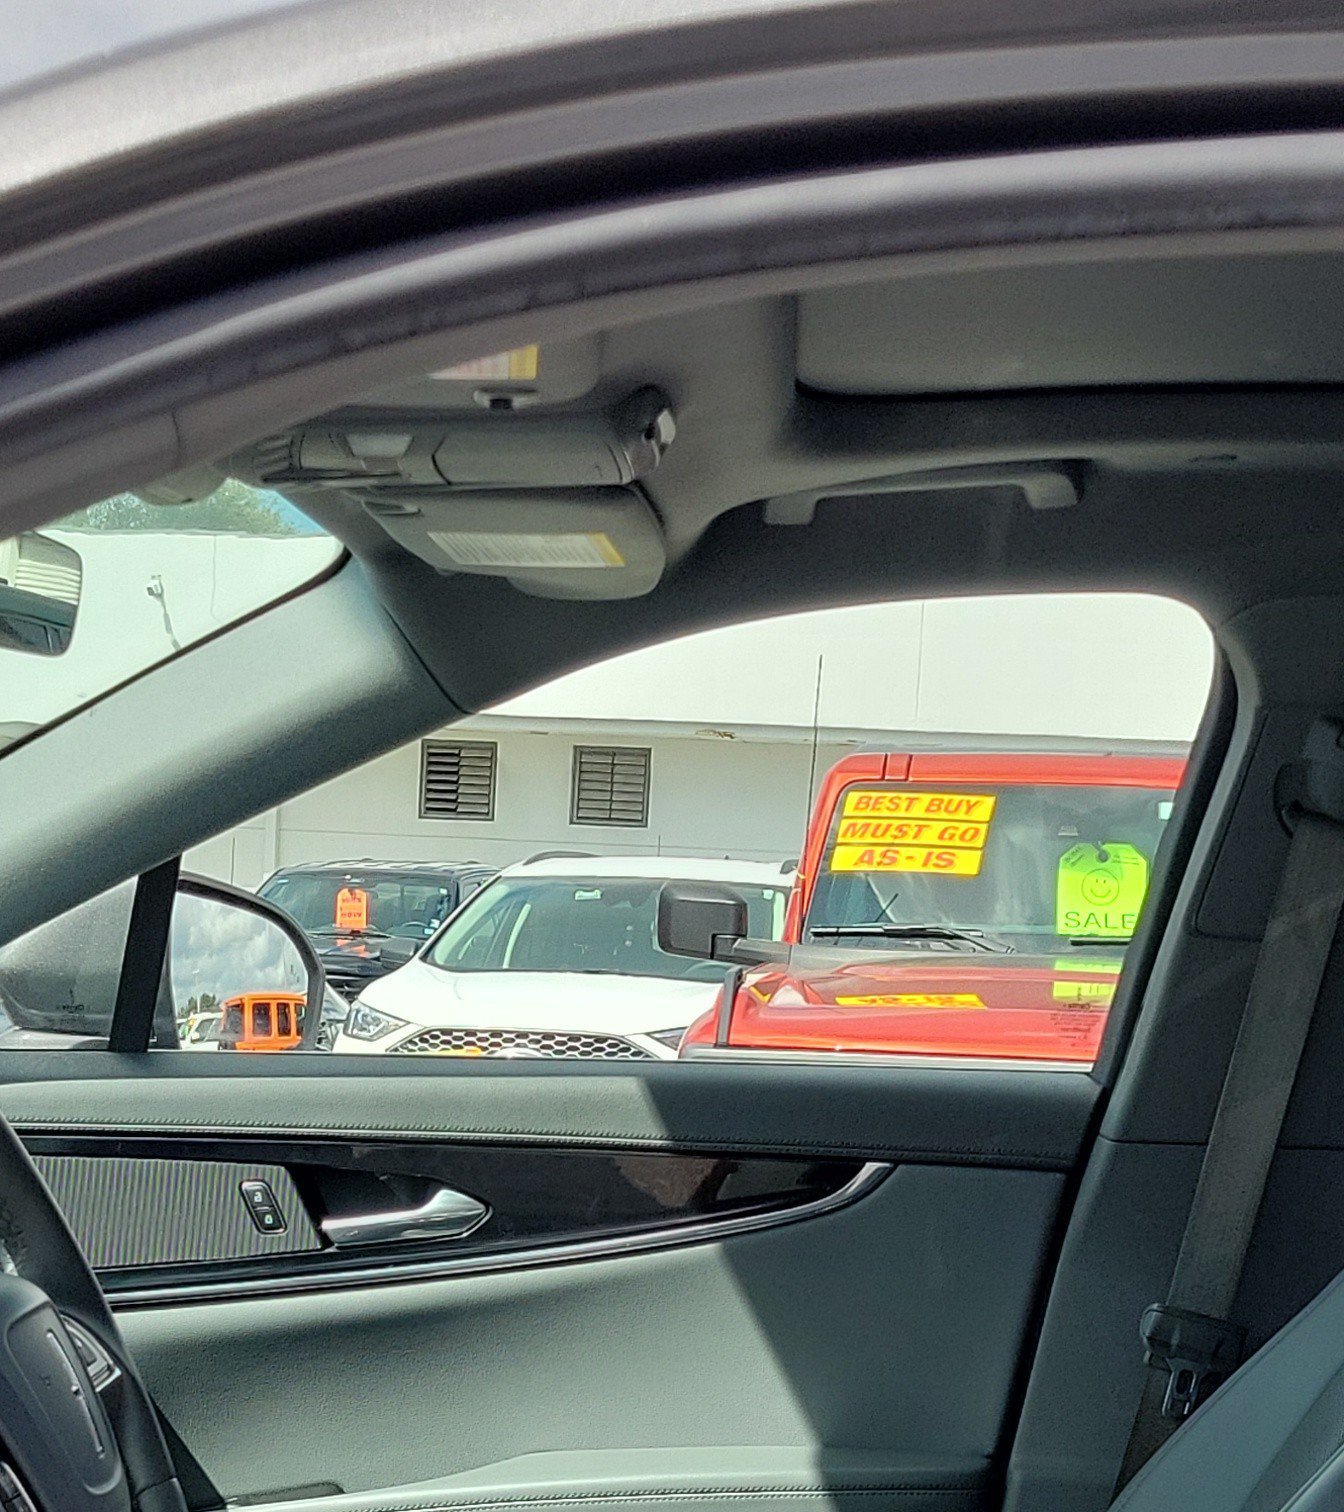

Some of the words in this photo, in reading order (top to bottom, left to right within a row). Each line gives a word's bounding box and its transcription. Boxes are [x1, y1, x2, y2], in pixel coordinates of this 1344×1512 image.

[853, 795, 920, 813] BEST
[924, 797, 982, 815] BUY
[841, 822, 929, 840] MUST
[937, 826, 981, 842] GO
[1065, 911, 1136, 930] SALE
